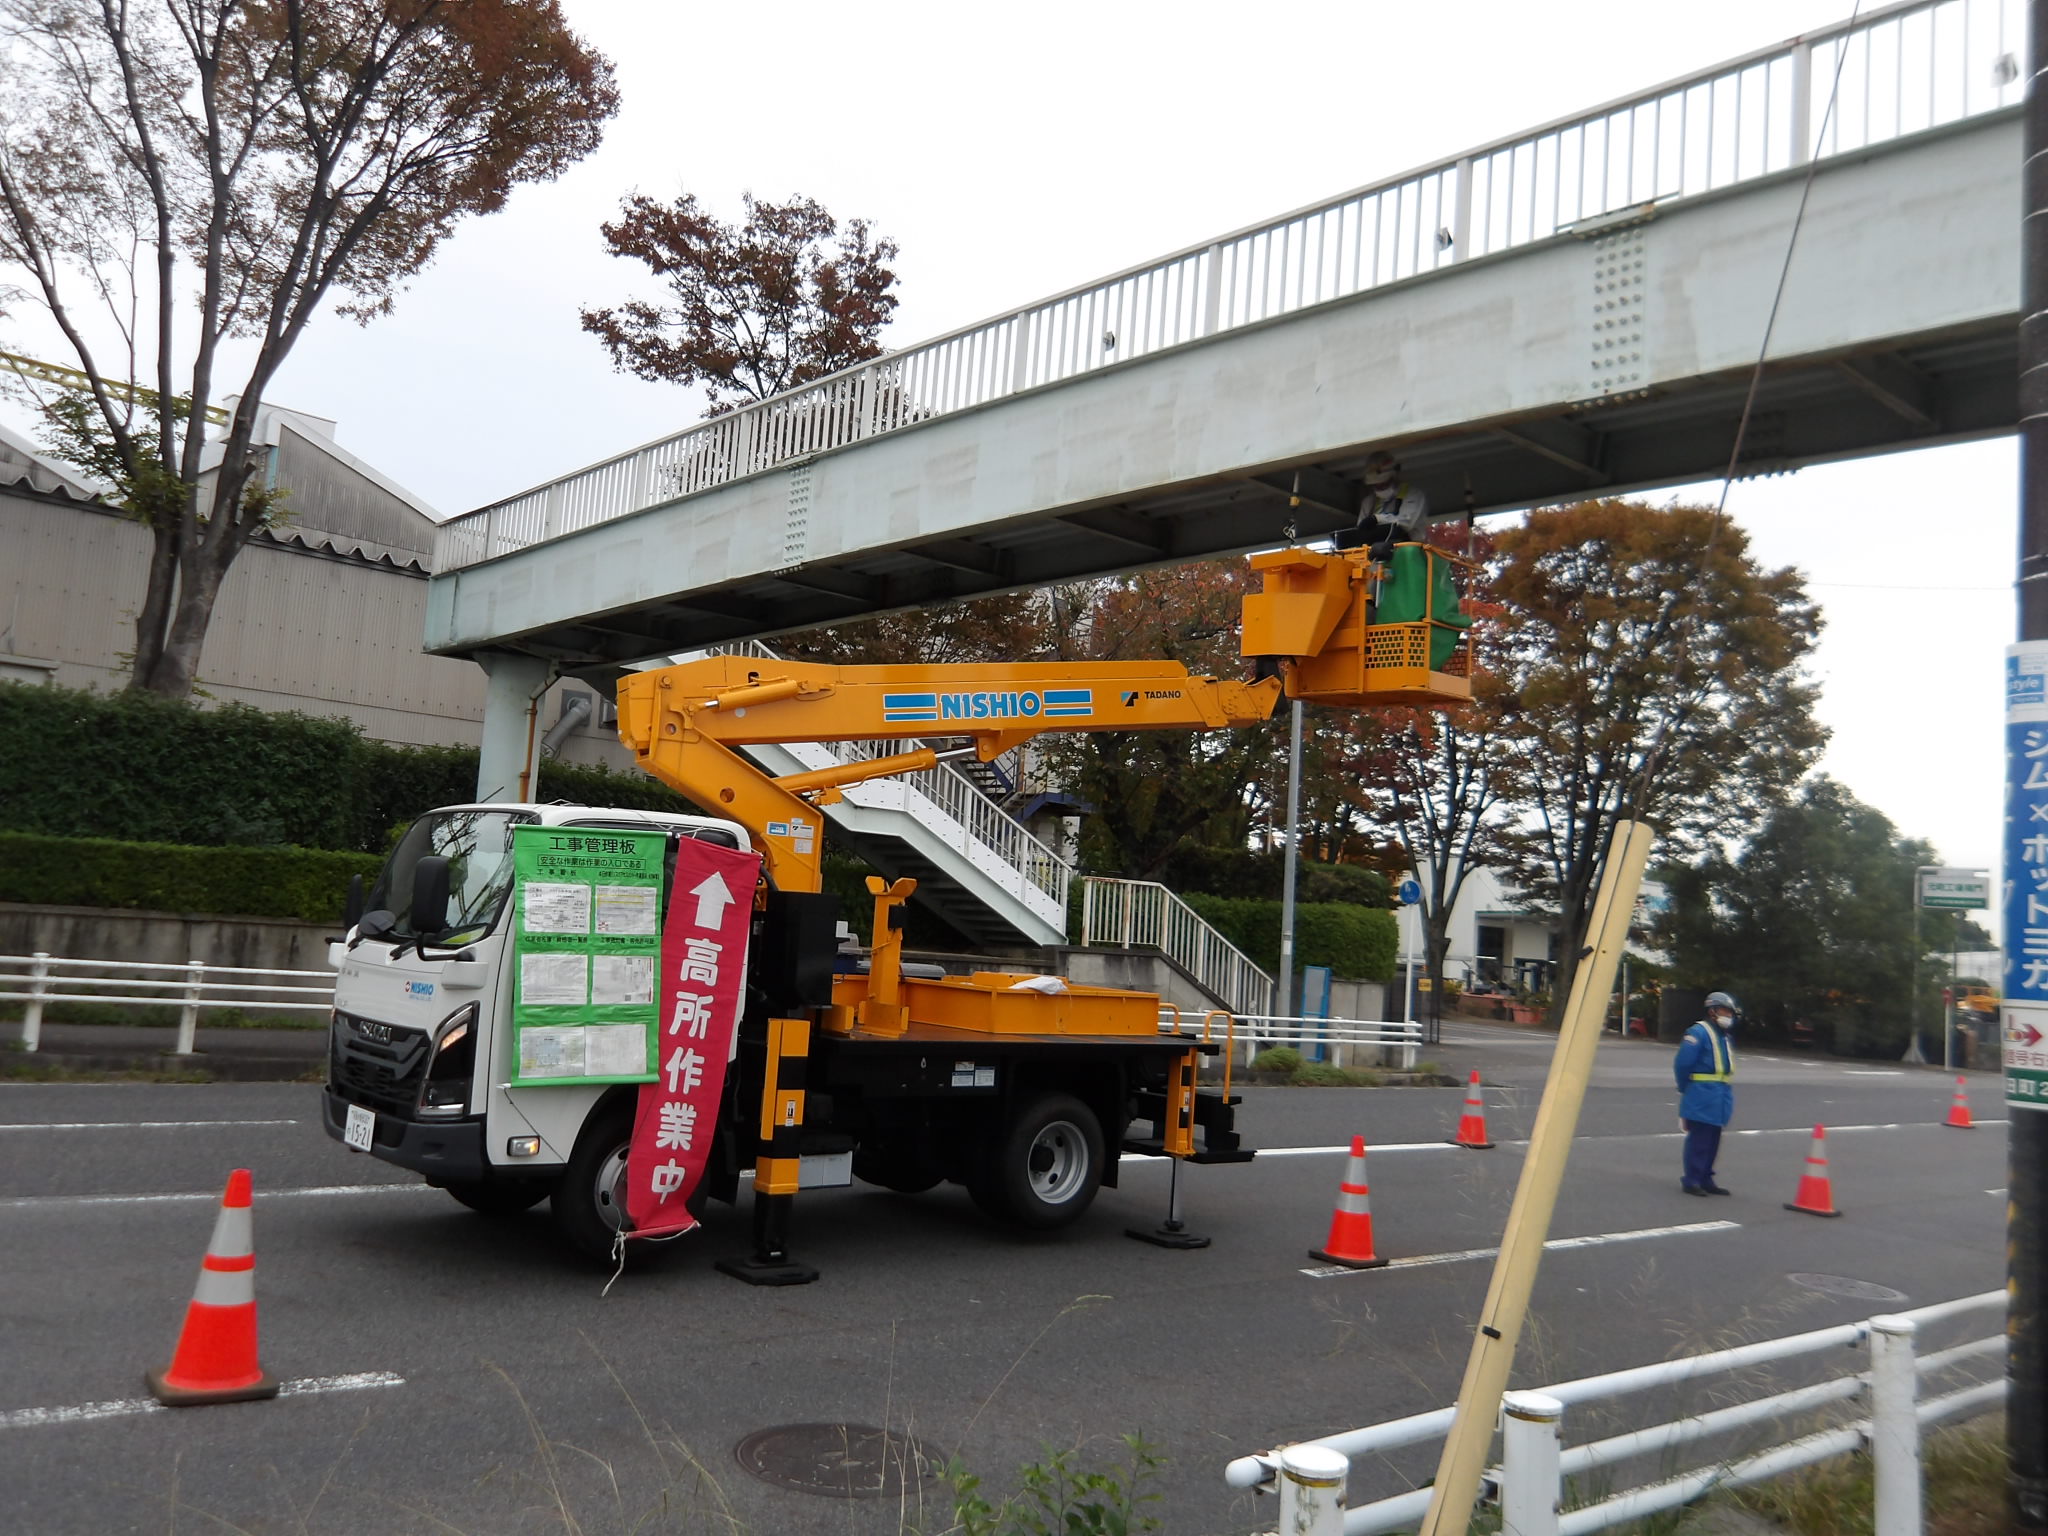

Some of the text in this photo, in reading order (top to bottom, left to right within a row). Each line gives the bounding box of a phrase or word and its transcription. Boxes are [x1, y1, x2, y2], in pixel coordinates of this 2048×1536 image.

[1144, 690, 1182, 699] TADANO
[940, 691, 1041, 720] NISHIO
[549, 836, 637, 855] 工事管理板
[410, 982, 434, 995] NISHIO
[2003, 1048, 2048, 1067] 信号右
[652, 937, 724, 1205] 高所作業中
